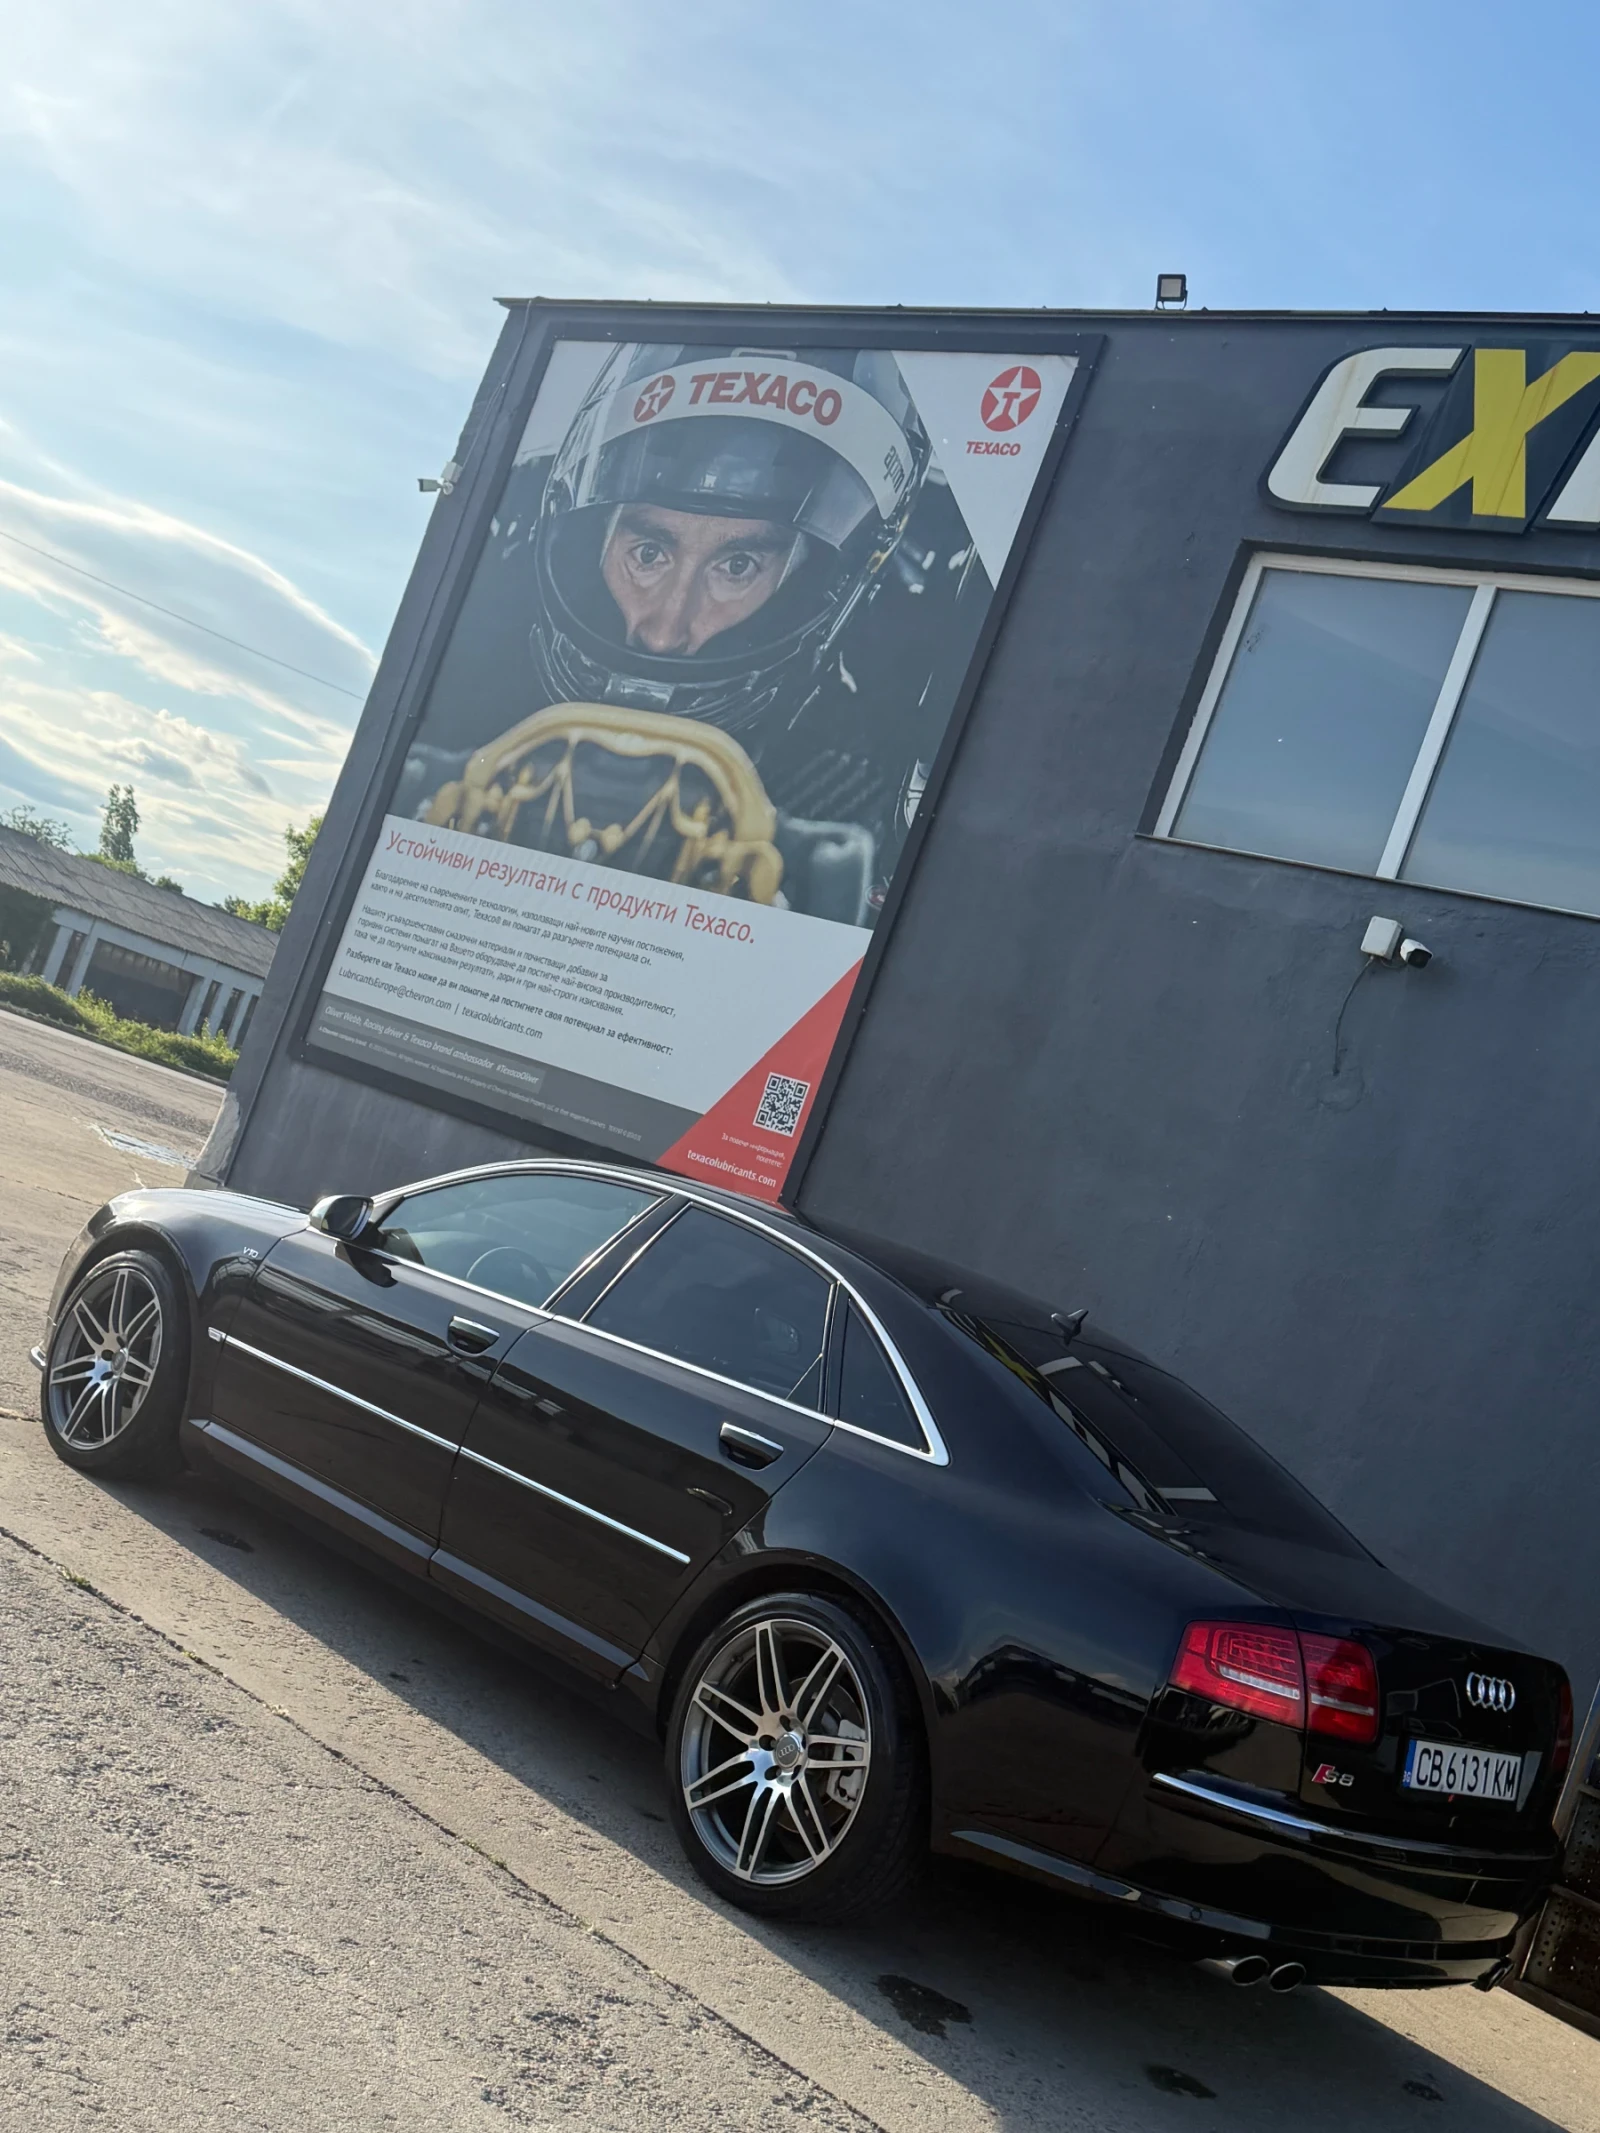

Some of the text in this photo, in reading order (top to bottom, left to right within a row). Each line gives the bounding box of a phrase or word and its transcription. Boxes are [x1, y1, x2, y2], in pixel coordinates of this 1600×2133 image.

[688, 371, 842, 426] TEXACO
[966, 441, 1021, 457] TEXACO
[1268, 347, 1600, 522] EX
[385, 830, 474, 871] Устойчиви
[475, 859, 567, 895] резултати
[571, 882, 583, 899] с
[586, 886, 677, 923] продукти
[461, 1006, 542, 1038] texacolubricants.com
[687, 1149, 776, 1187] texacolubricants.com
[1322, 1769, 1355, 1787] S8
